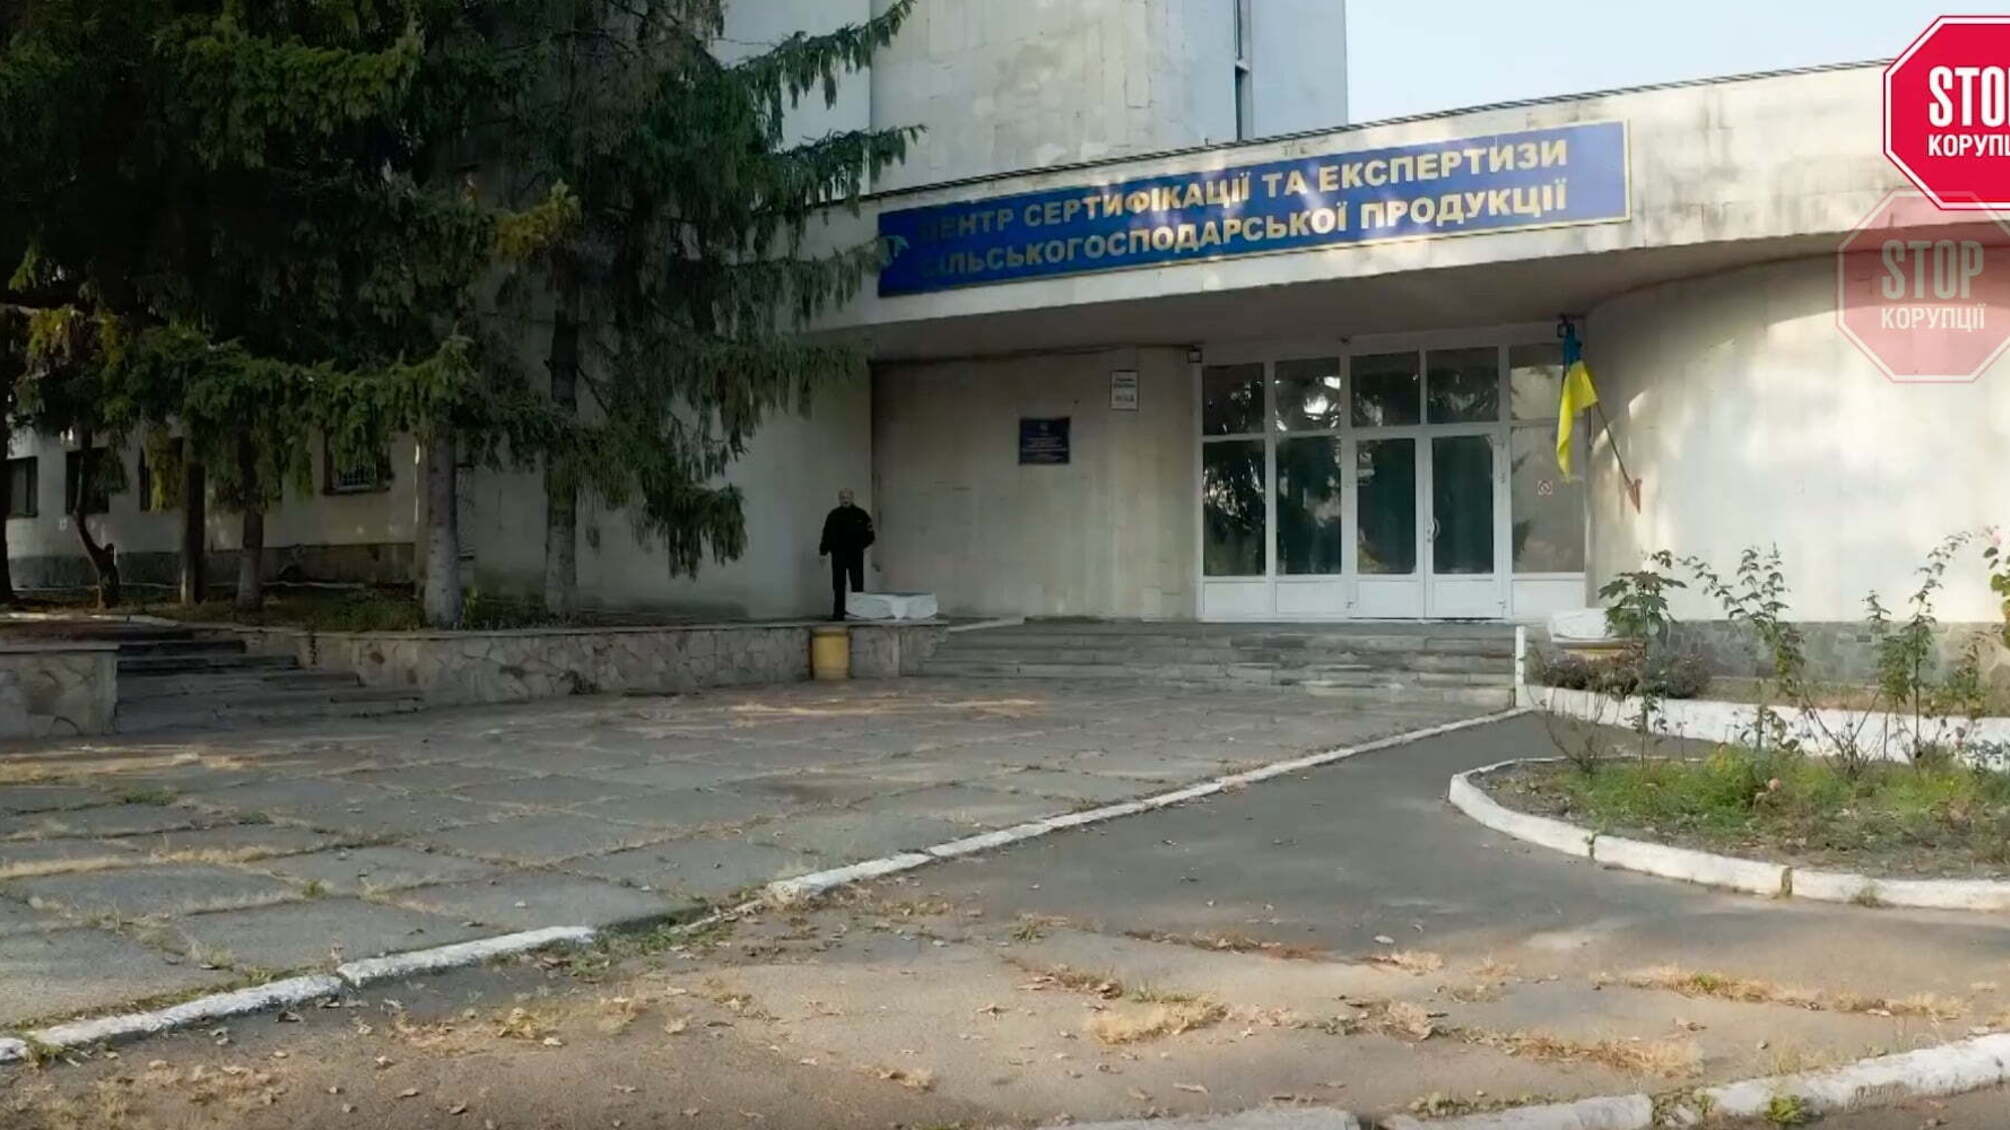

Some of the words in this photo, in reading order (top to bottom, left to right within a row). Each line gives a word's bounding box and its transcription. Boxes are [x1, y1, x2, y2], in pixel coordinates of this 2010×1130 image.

[1023, 172, 1251, 229] СЕРТИФІКАЦІЇ
[1262, 168, 1308, 198] ТА
[1317, 139, 1568, 193] ЕКСПЕРТИЗИ
[1360, 178, 1568, 230] ПРОДУКЦІЇ
